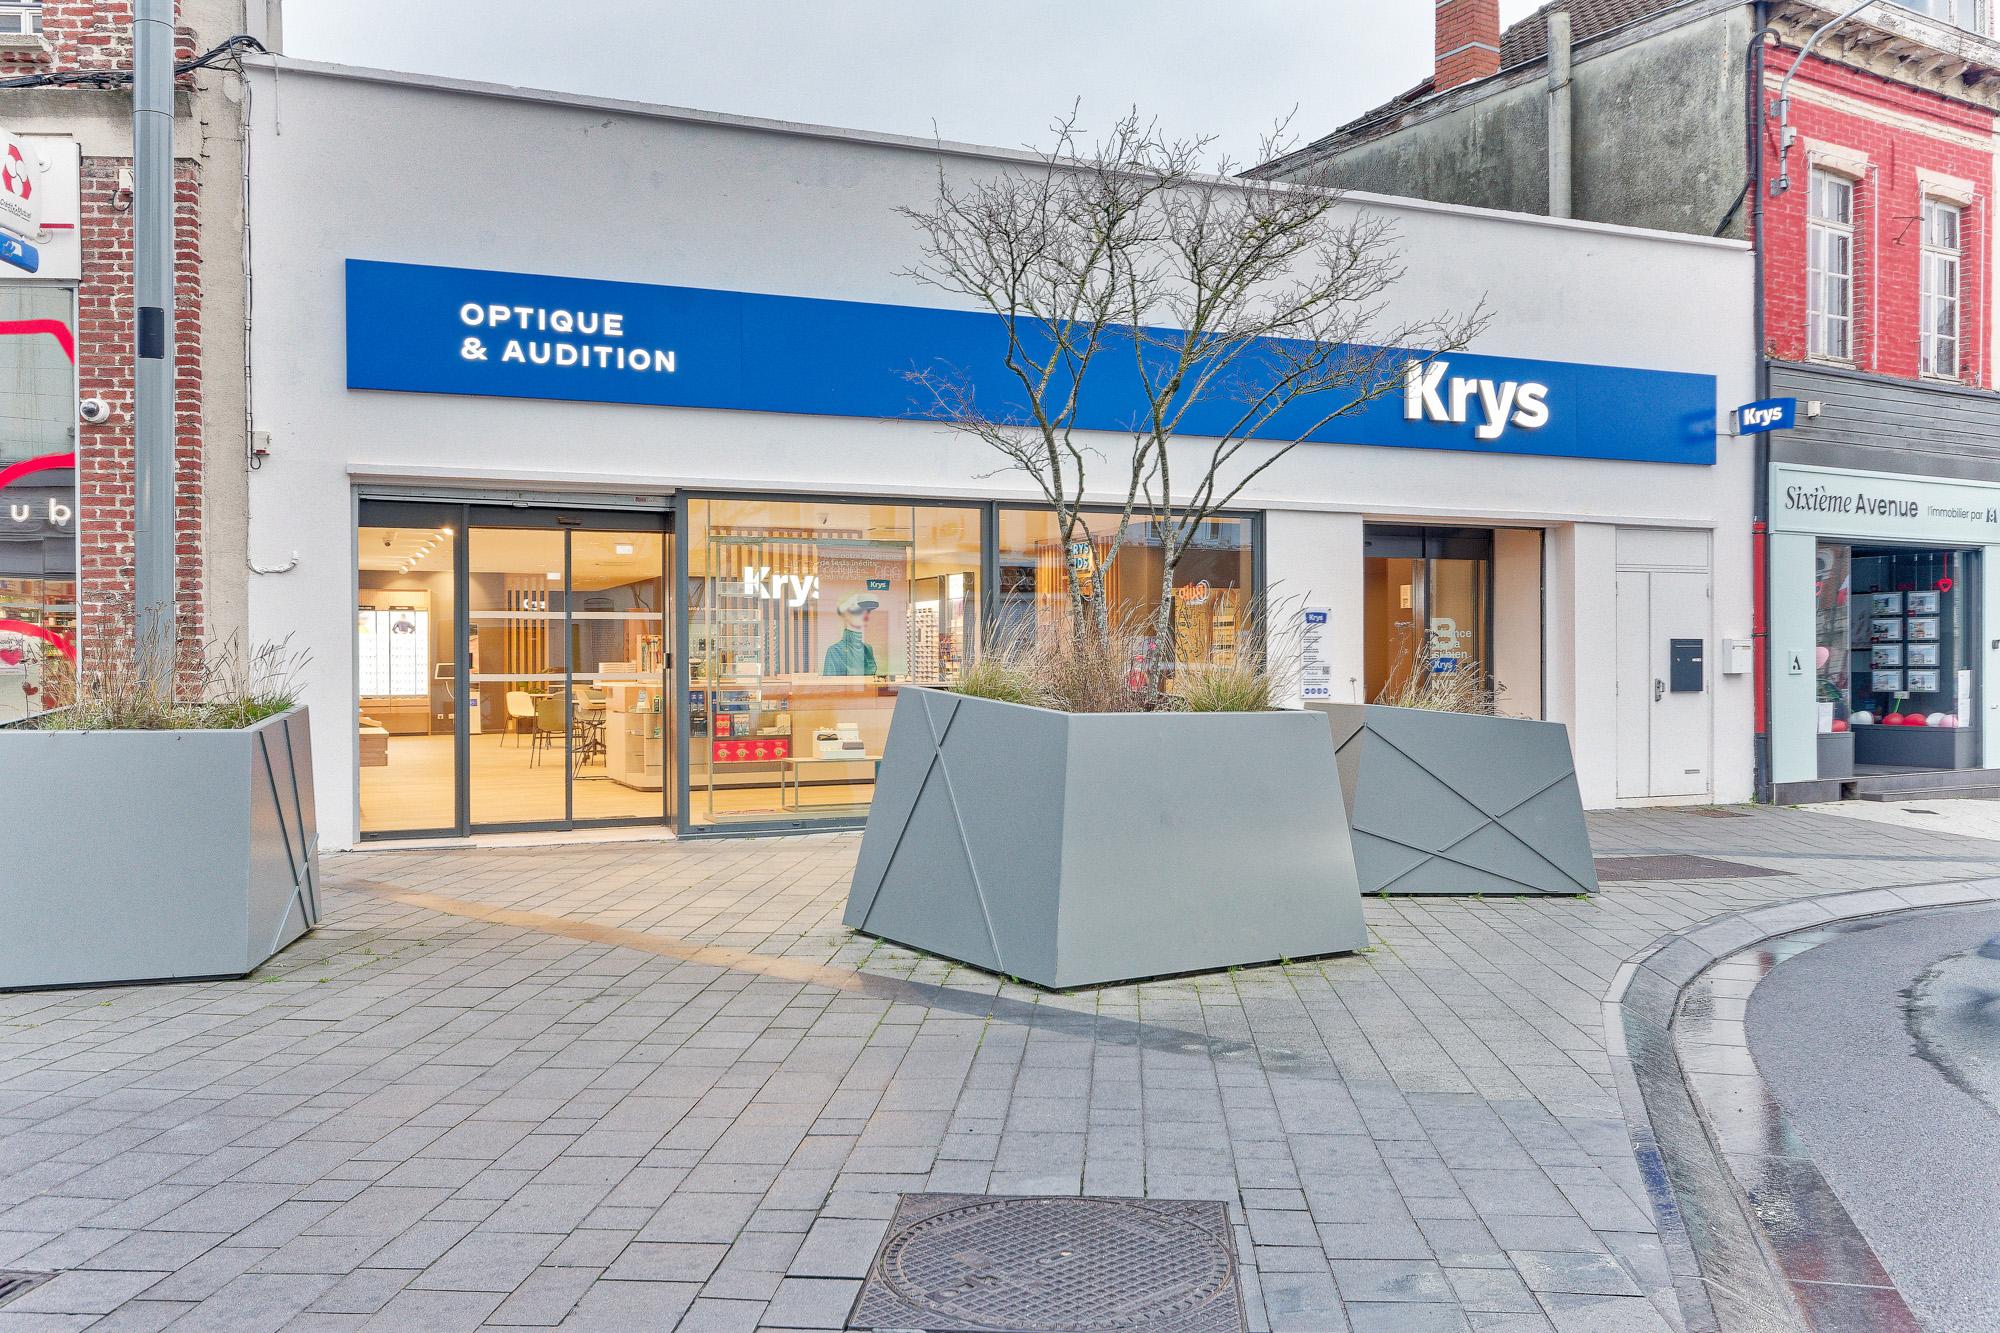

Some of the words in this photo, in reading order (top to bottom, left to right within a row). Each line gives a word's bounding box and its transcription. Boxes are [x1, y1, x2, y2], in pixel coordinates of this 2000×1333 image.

[459, 302, 624, 337] OPTIQUE
[461, 336, 489, 361] &
[502, 339, 676, 373] AUDITION
[1404, 360, 1549, 440] Krys
[1743, 405, 1783, 427] Krys
[1785, 486, 1852, 513] Sixième
[1855, 494, 1918, 518] Avenue
[1927, 506, 1969, 519] l'immobilier
[1971, 511, 1983, 522] par
[870, 581, 887, 589] Krys
[1308, 613, 1324, 622] Krys
[1433, 659, 1454, 671] Krys
